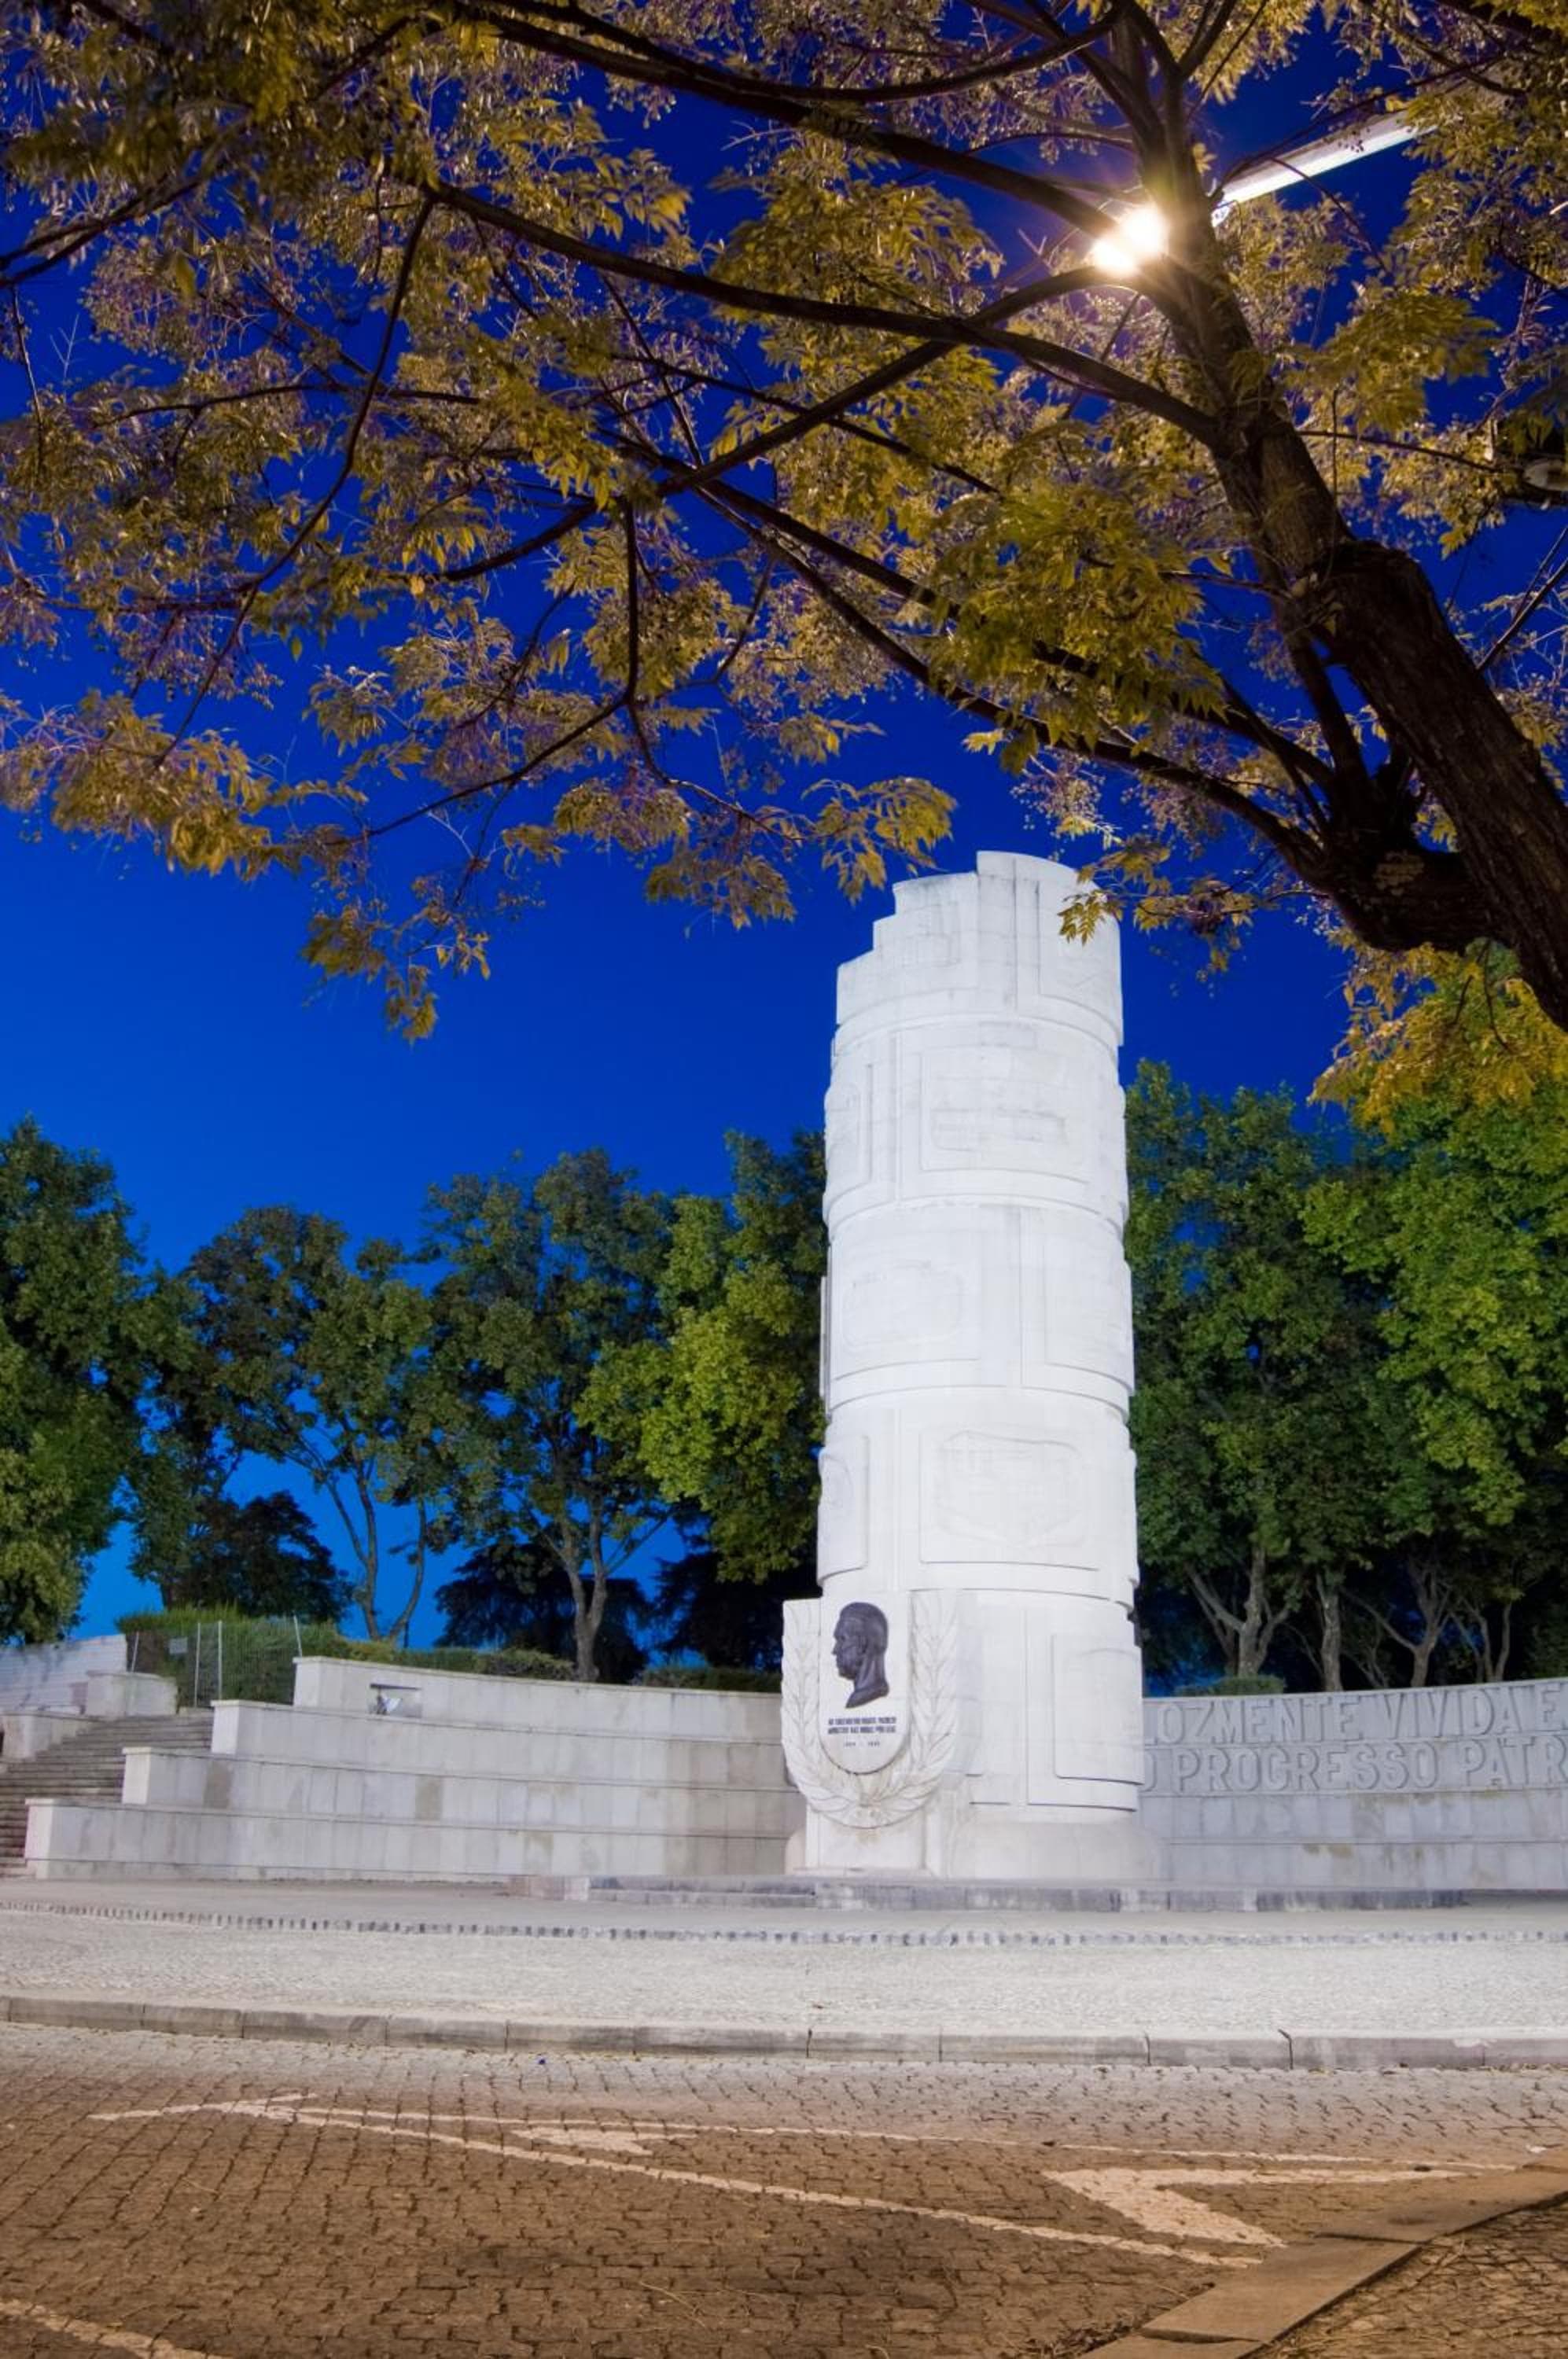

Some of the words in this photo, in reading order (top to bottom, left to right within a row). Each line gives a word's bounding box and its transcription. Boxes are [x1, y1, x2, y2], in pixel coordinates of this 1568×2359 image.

[1145, 1695, 1363, 1746] OZMENTE
[1375, 1687, 1522, 1739] VIVIDA
[1172, 1741, 1439, 1793] PROGRESSO
